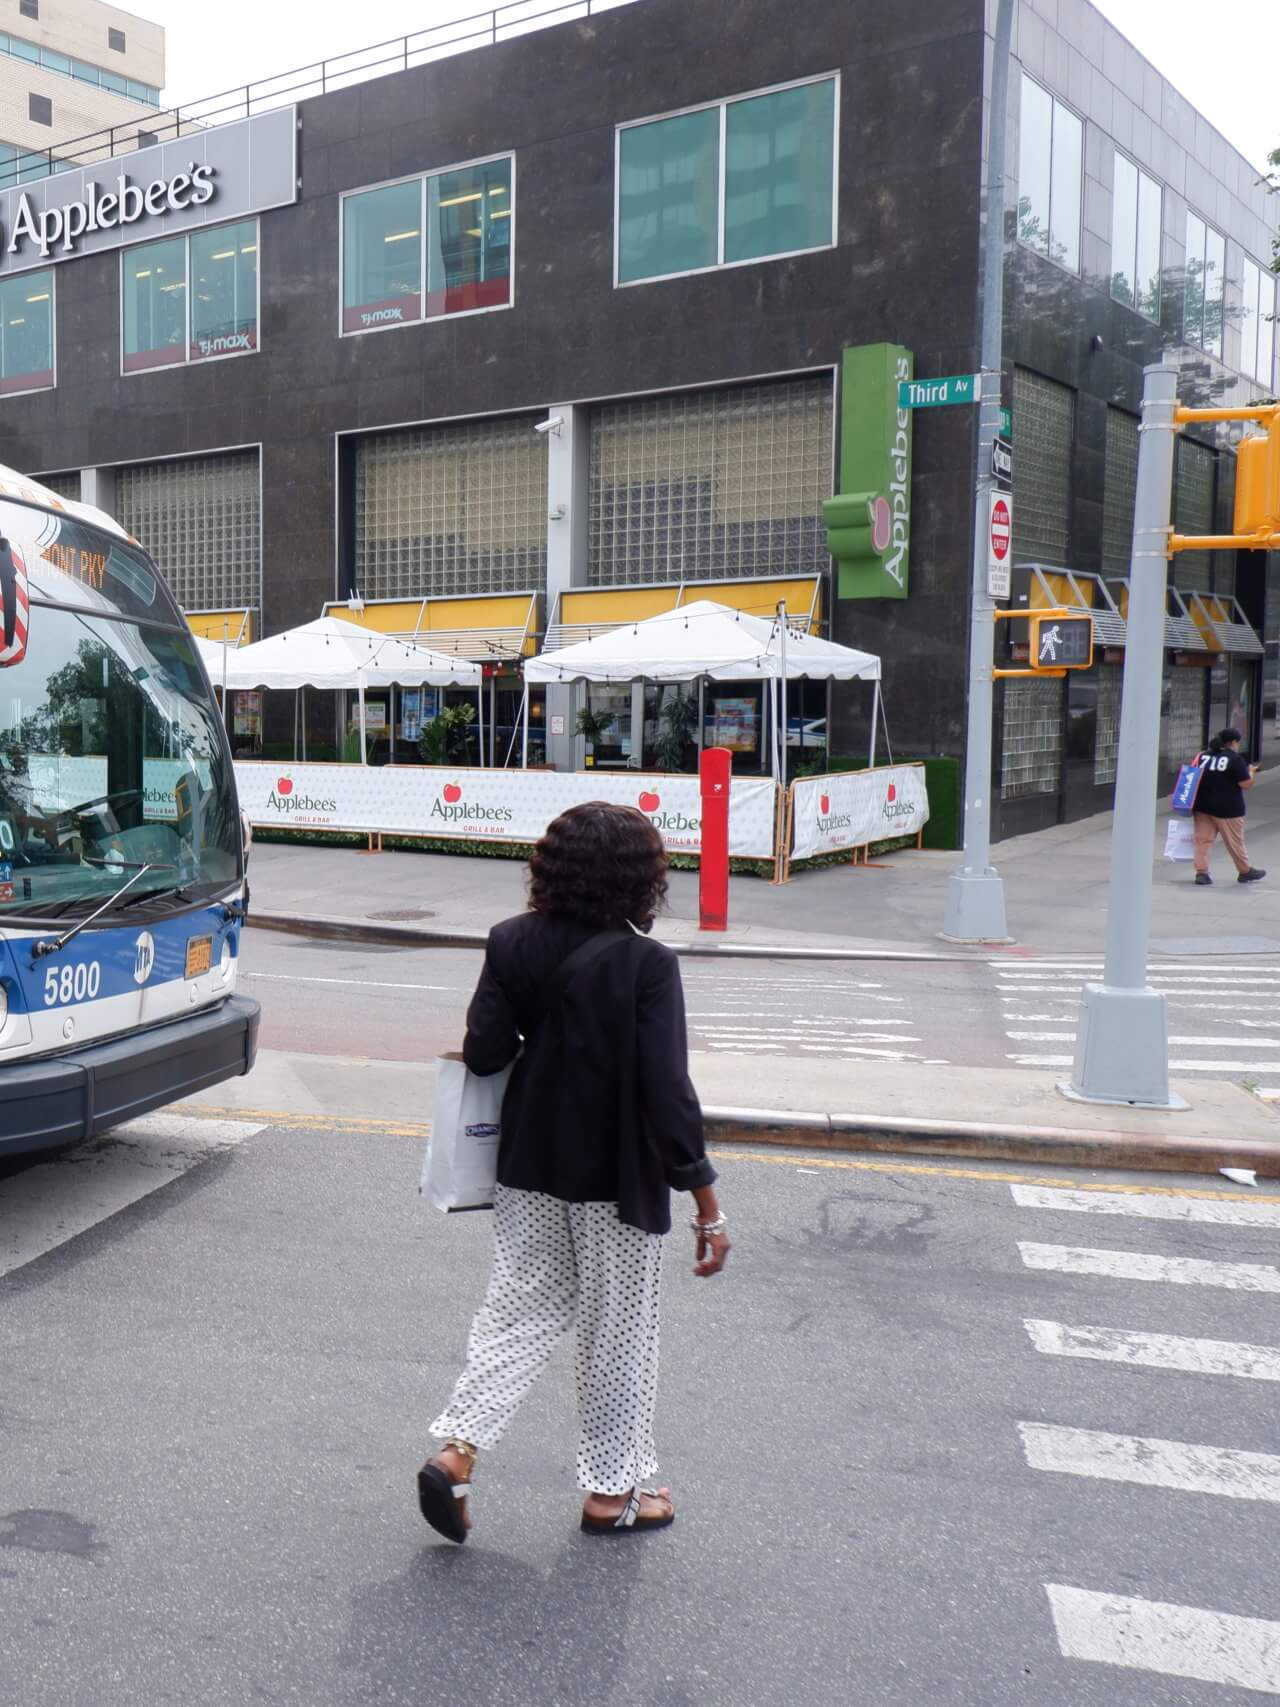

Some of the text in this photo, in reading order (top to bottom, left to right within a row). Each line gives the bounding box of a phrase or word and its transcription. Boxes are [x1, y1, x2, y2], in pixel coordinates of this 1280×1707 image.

[7, 162, 217, 257] Applebee's
[909, 380, 968, 403] Third Av
[885, 358, 909, 588] Applebe's
[80, 551, 106, 590] PKY
[1200, 755, 1228, 772] 718
[267, 790, 337, 813] Applebee's
[430, 798, 512, 822] Applebee's
[44, 961, 100, 1006] 5800
